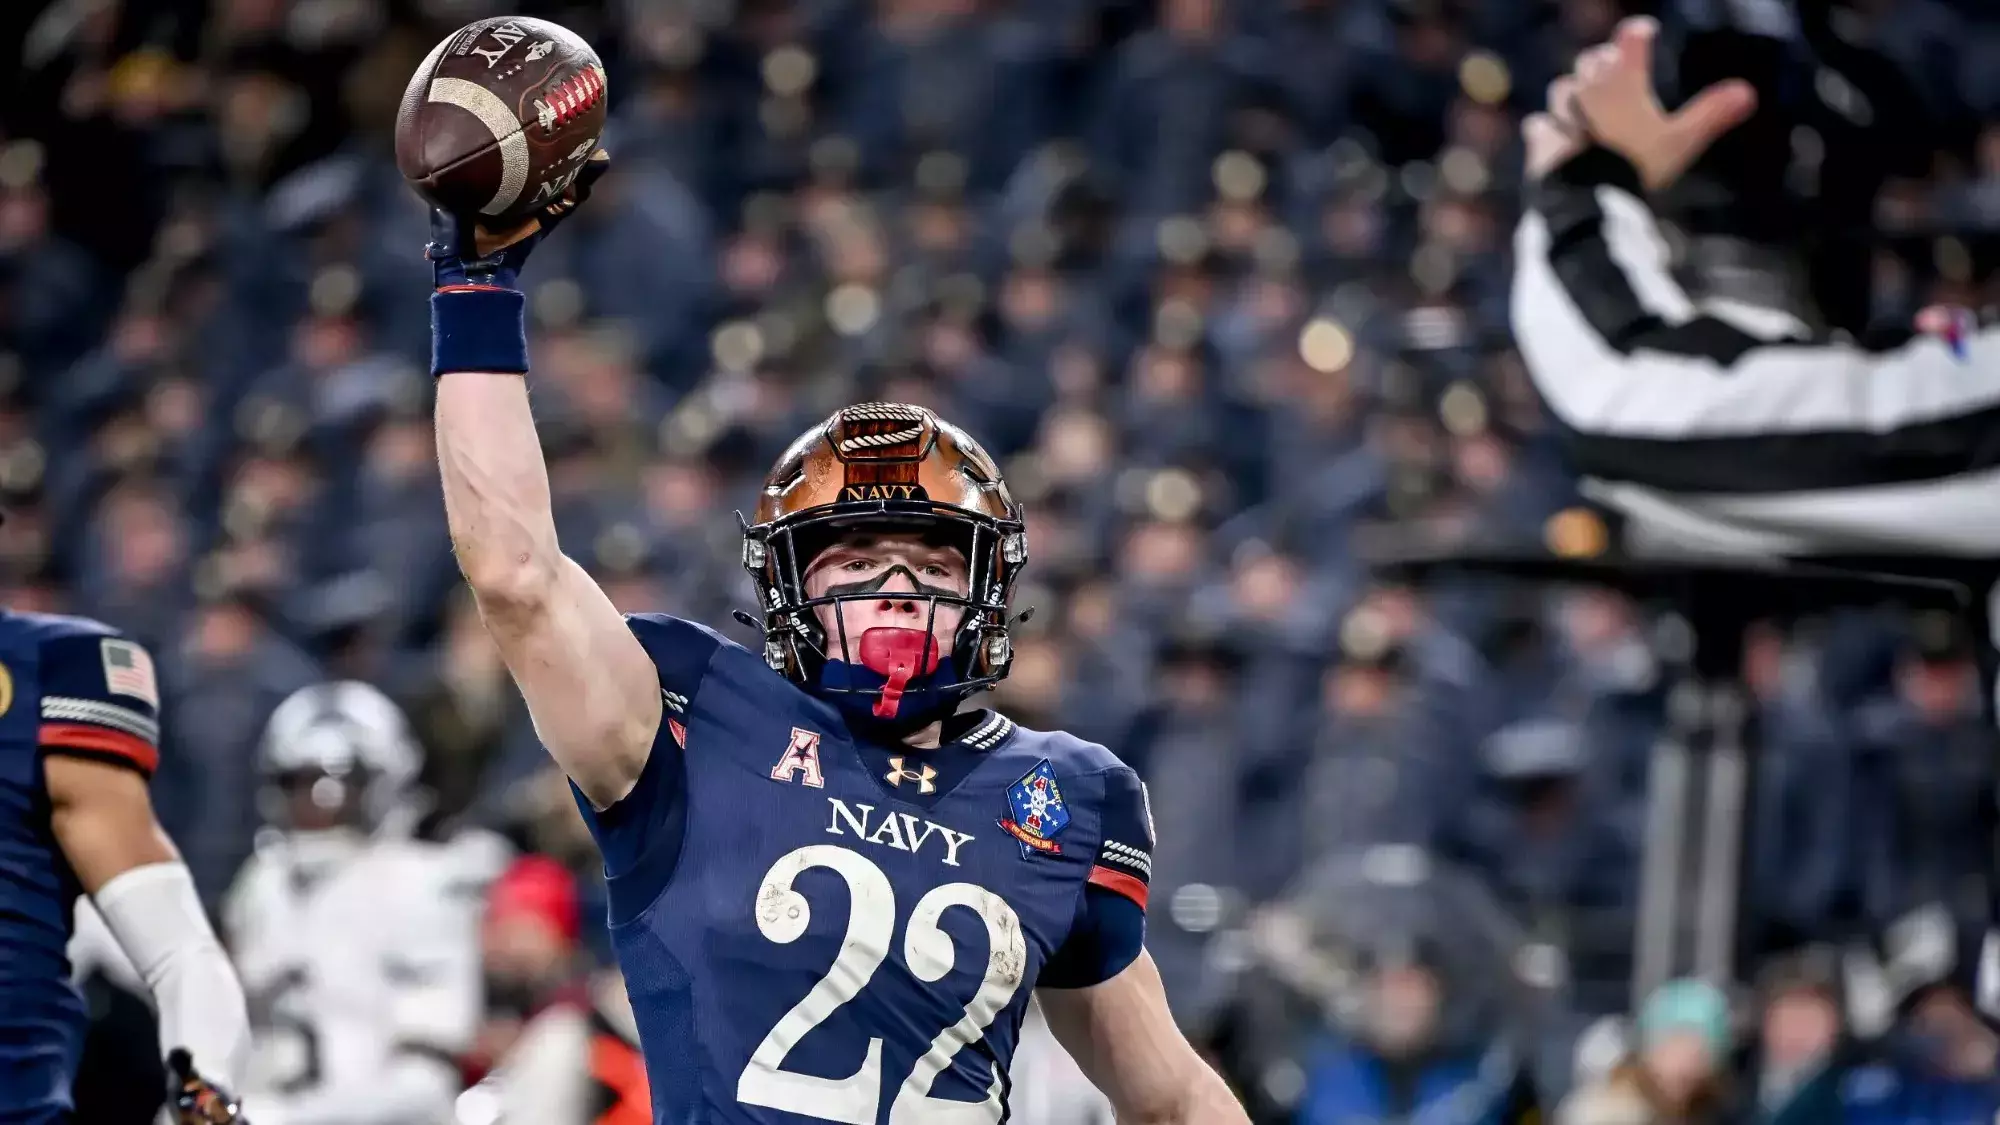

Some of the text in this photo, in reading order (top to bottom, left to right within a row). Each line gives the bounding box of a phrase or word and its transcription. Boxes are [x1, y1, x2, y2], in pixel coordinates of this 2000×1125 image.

[470, 20, 528, 69] AVY
[845, 485, 918, 501] NAVY
[825, 797, 976, 867] NAVY
[1021, 823, 1045, 838] DEADLY
[737, 844, 1027, 1125] 22
